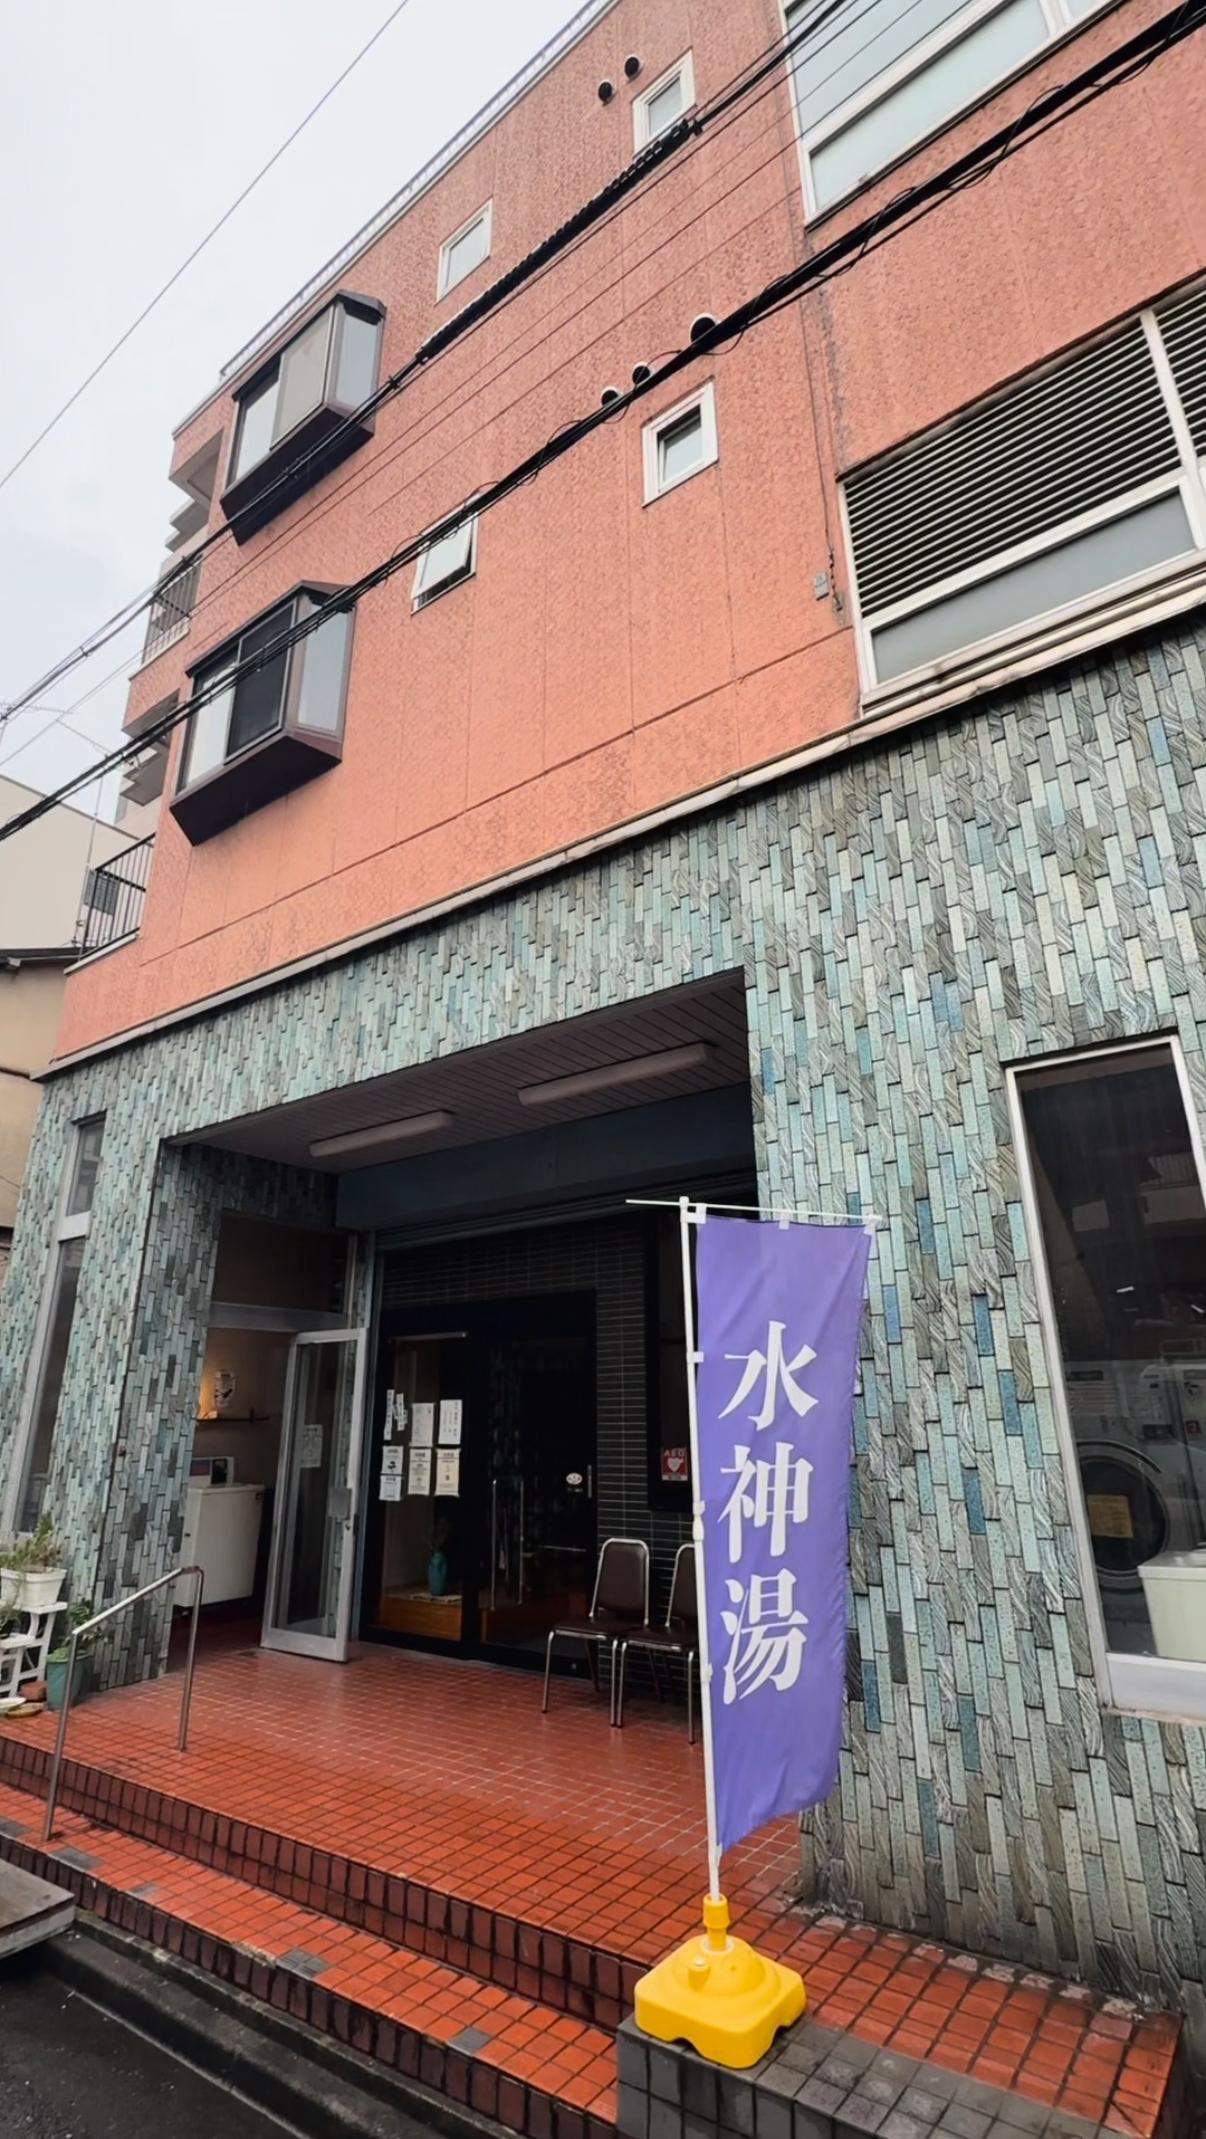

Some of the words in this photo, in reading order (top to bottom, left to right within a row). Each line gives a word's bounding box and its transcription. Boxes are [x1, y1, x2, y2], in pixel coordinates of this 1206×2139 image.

[664, 1448, 686, 1457] AED
[717, 1320, 819, 1705] 水神湯
